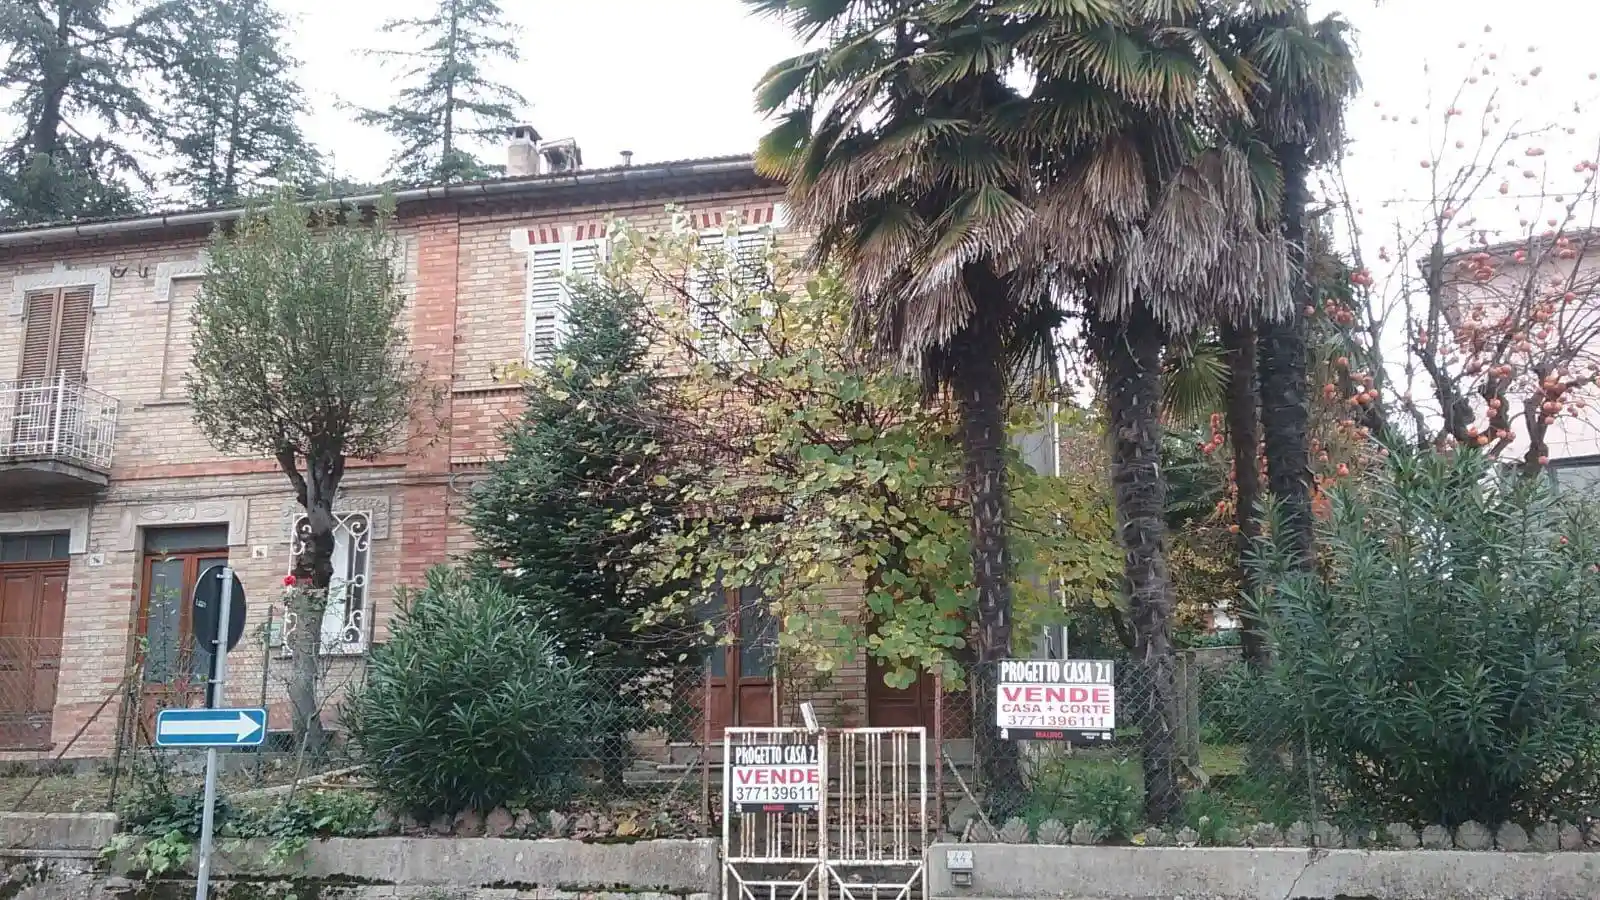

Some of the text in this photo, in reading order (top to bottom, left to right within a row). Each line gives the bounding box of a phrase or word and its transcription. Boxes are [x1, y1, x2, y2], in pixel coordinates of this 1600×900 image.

[1001, 661, 1110, 683] PROGETTO CASA 2.1
[1002, 687, 1110, 703] VENDE
[1002, 703, 1042, 713] CASA
[1060, 704, 1111, 714] CORTE
[1008, 715, 1104, 726] 3771396111
[735, 745, 818, 764] PROGETTO CASA 2.
[737, 768, 819, 784] VENDE
